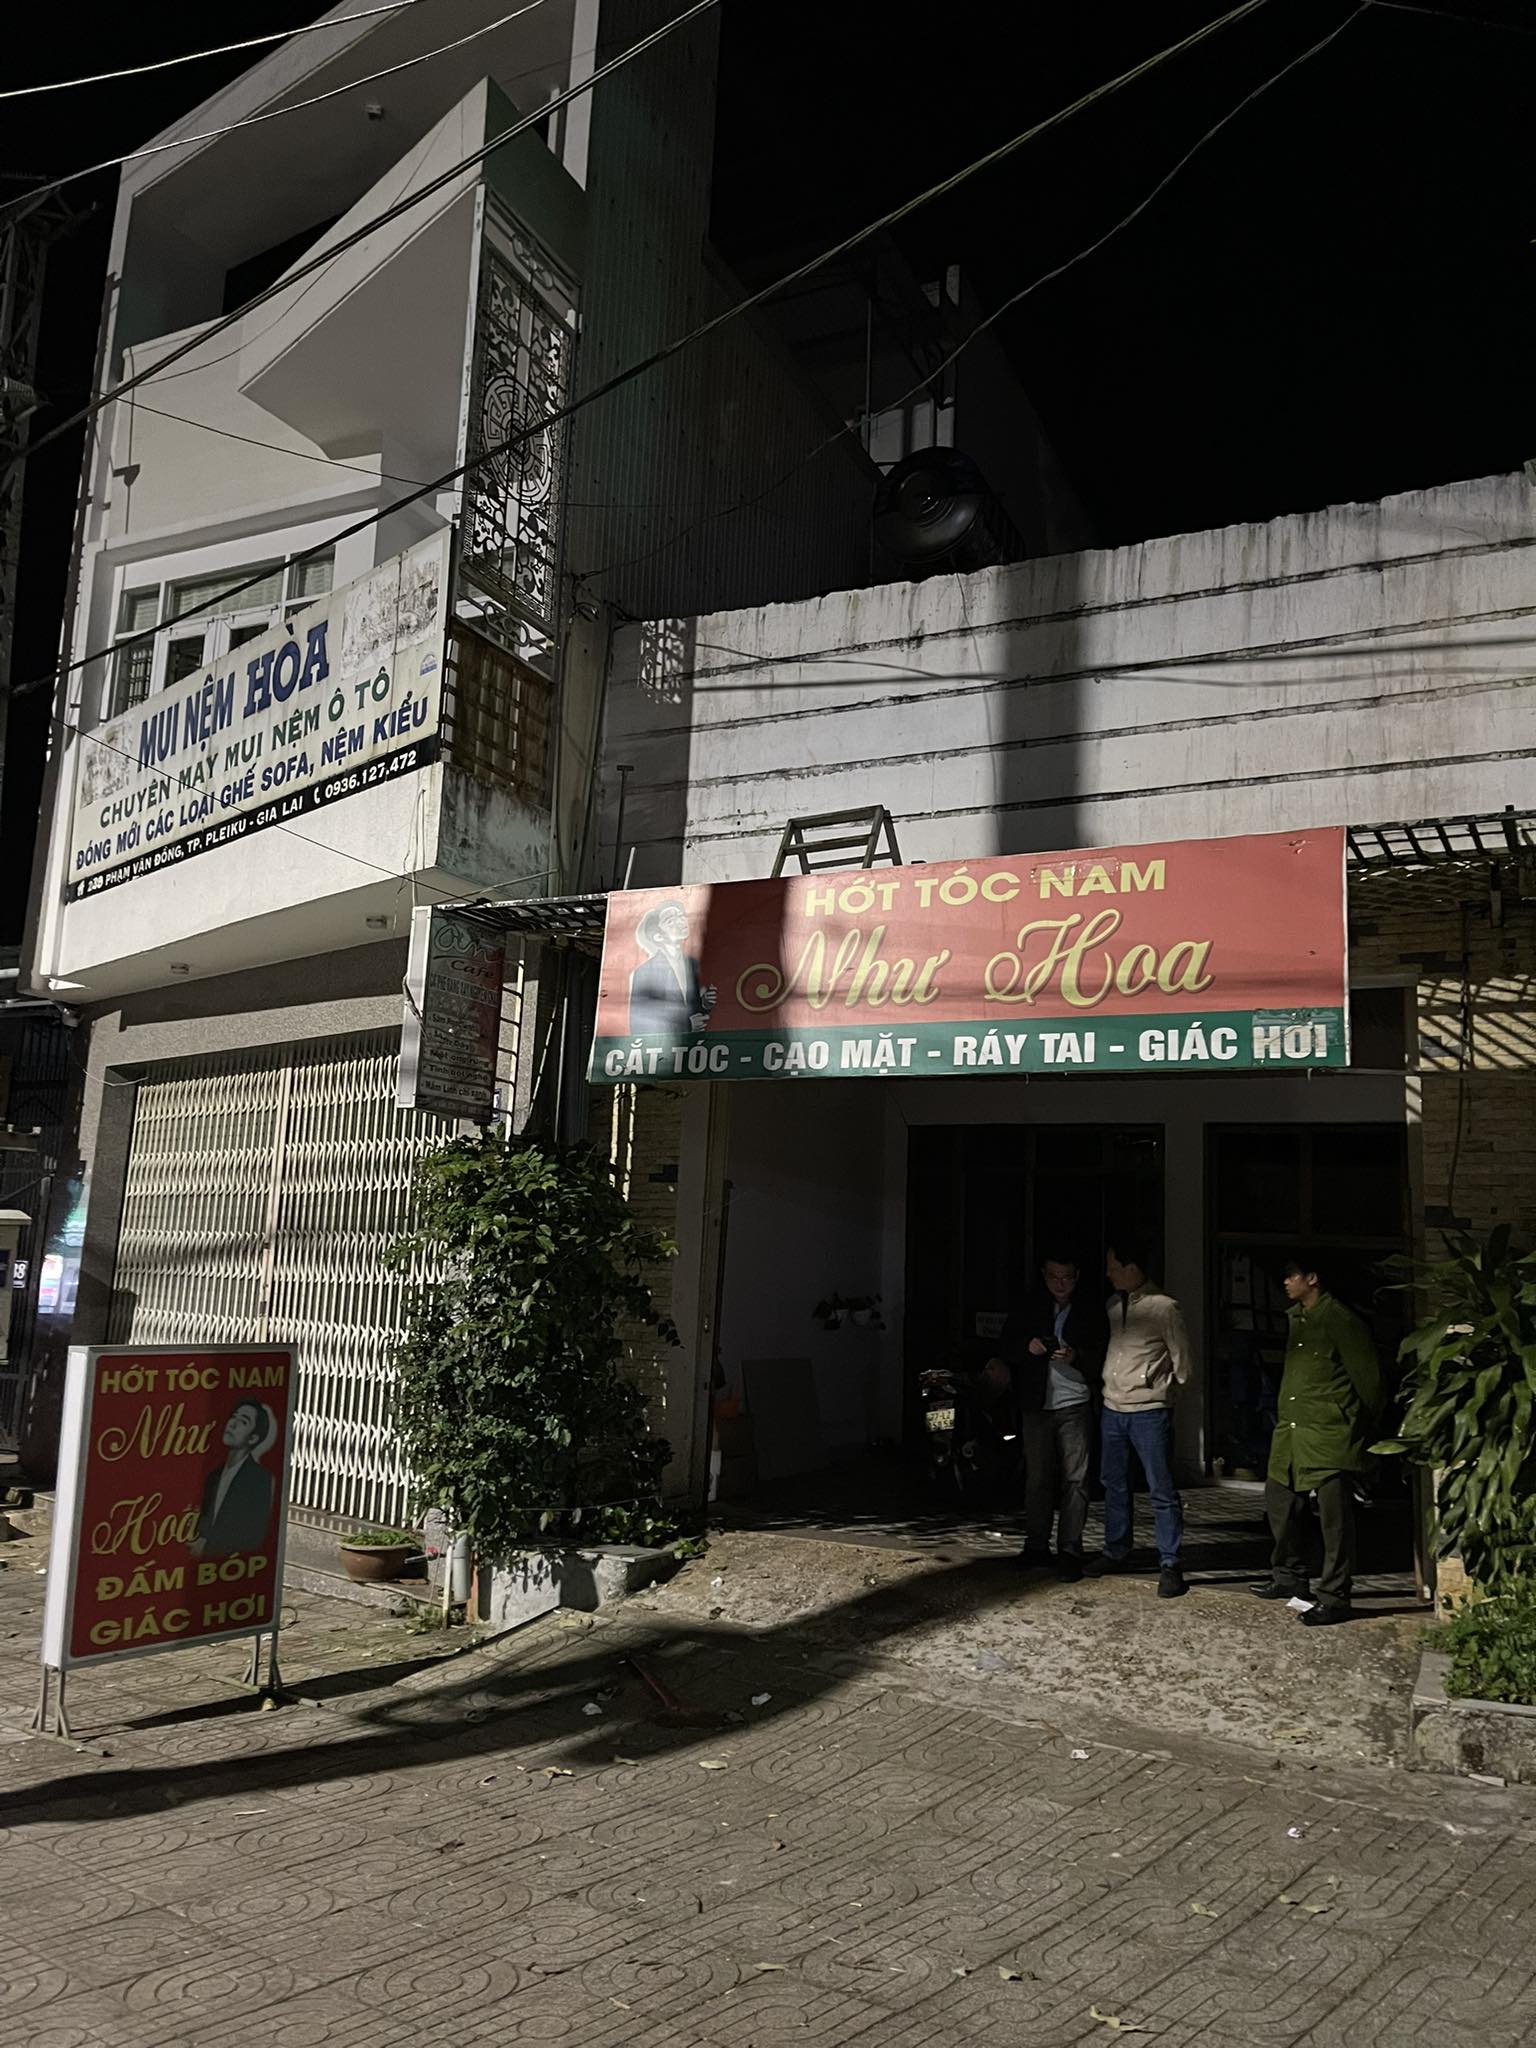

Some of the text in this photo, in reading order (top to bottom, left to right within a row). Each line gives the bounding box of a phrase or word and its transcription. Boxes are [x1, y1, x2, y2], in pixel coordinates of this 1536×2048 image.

[137, 620, 330, 773] MUI NỆM HÒA
[100, 666, 390, 828] CHUYÊN MAY MUI NỆM Ô TÔ
[76, 691, 428, 870] ĐÓNG MỚI CÁC LOẠI GHẾ SOFA, NỆM KIỂU
[187, 839, 203, 853] TP.
[205, 818, 246, 846] PLEIKU
[256, 806, 277, 825] GIA
[282, 795, 304, 816] LAI
[325, 750, 417, 799] 0936.127.472
[805, 859, 1166, 918] HỚT TÓC NAM
[736, 908, 1214, 1010] Như Hoa
[604, 1038, 663, 1077] CẮT
[671, 1040, 729, 1074] TÓC
[840, 1032, 917, 1075] MẶT
[952, 1029, 1027, 1067] RÁY
[1039, 1031, 1095, 1064] TAI
[1138, 1021, 1238, 1062] GIÁC
[1252, 1021, 1328, 1059] HƠI
[100, 1361, 285, 1394] HỚT TÓC NAM
[97, 1403, 216, 1462] Như
[96, 1553, 268, 1601] ĐẤM BÓP
[90, 1594, 265, 1645] GIÁC HƠI
